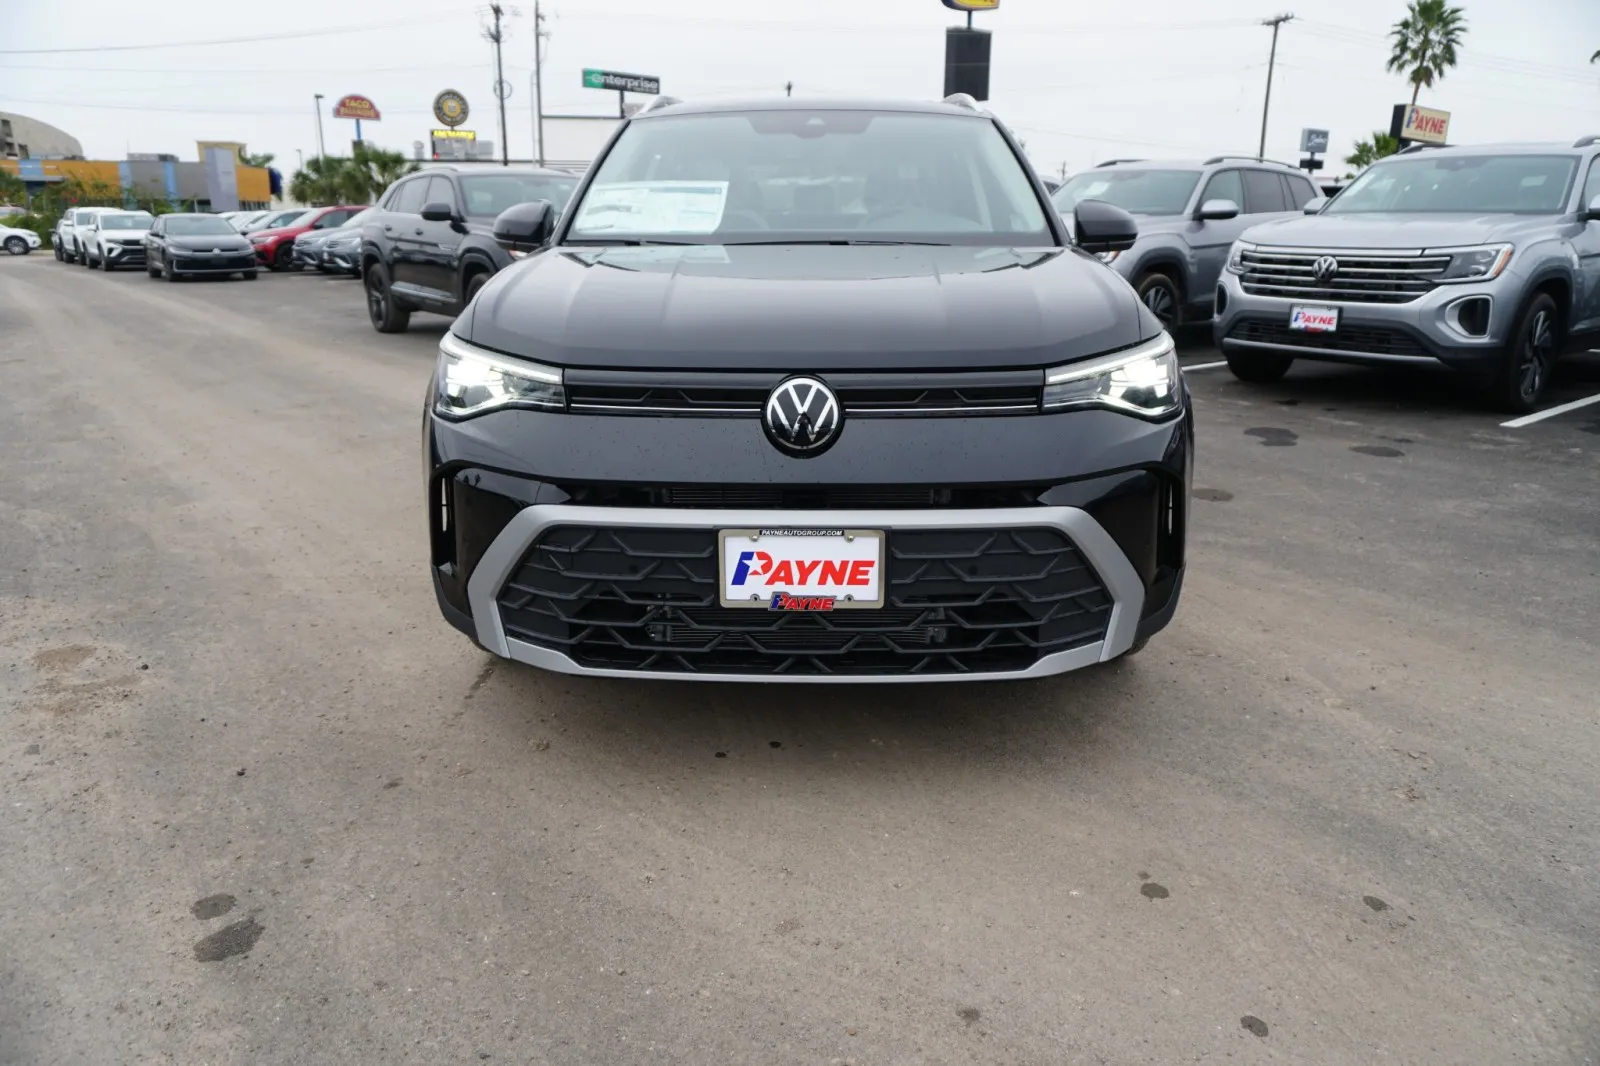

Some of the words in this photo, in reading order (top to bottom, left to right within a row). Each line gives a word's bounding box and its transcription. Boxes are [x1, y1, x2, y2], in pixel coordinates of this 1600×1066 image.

[591, 73, 658, 89] enterprise
[1406, 107, 1446, 134] PAYNE
[1293, 312, 1336, 325] PAYNE
[731, 551, 876, 586] PAYNE
[770, 592, 835, 611] PAYNE
